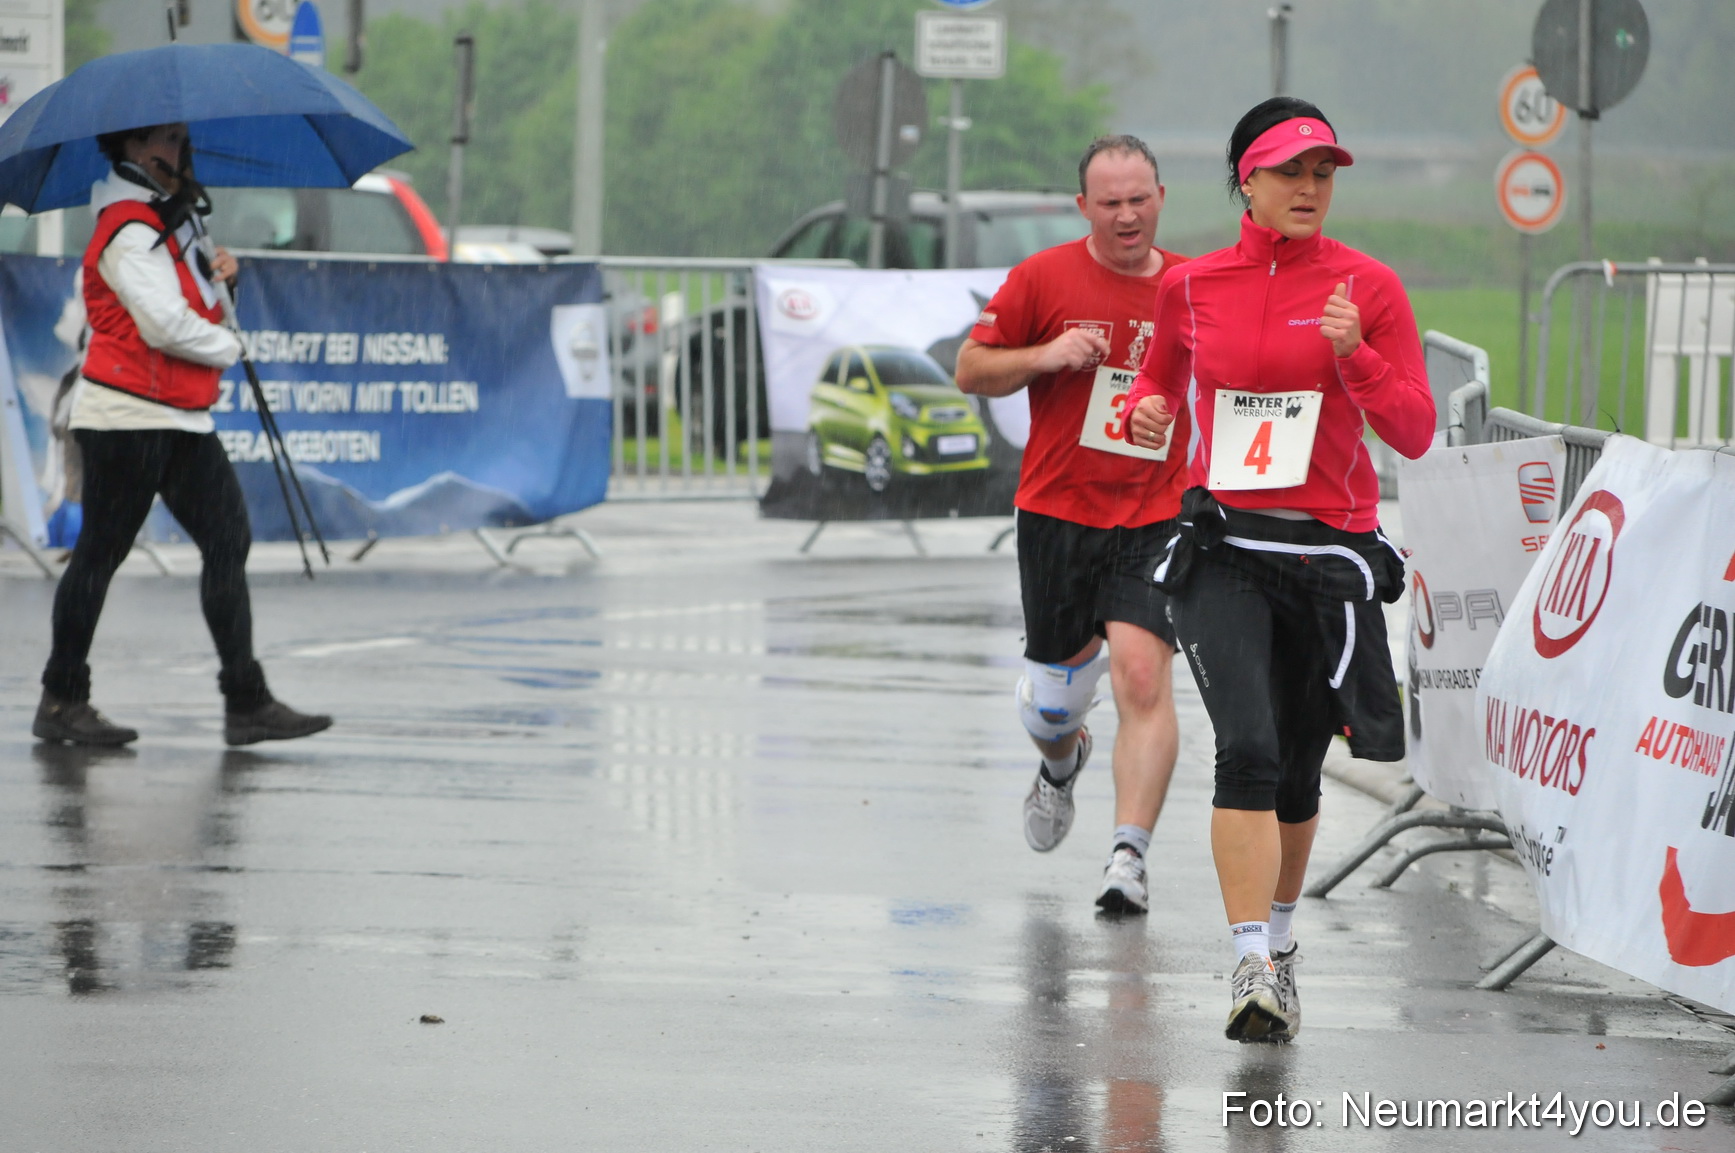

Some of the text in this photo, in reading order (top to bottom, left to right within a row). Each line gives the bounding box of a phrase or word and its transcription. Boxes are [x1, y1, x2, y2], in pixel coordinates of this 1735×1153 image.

[1515, 86, 1554, 124] 60
[324, 332, 358, 364] BEI
[362, 332, 449, 364] NISSAN:
[291, 381, 350, 413] VORN
[355, 381, 397, 412] MIT
[398, 381, 479, 413] TOLLEN
[1233, 407, 1282, 418] WERBUNG
[1234, 396, 1283, 408] MEYER
[1104, 393, 1127, 441] 3
[1243, 421, 1273, 475] 4
[1521, 534, 1549, 552] SE
[1544, 532, 1602, 622] KIA
[1486, 695, 1596, 797] KIA MOTORS
[1635, 715, 1726, 778] AUTOHAUS
